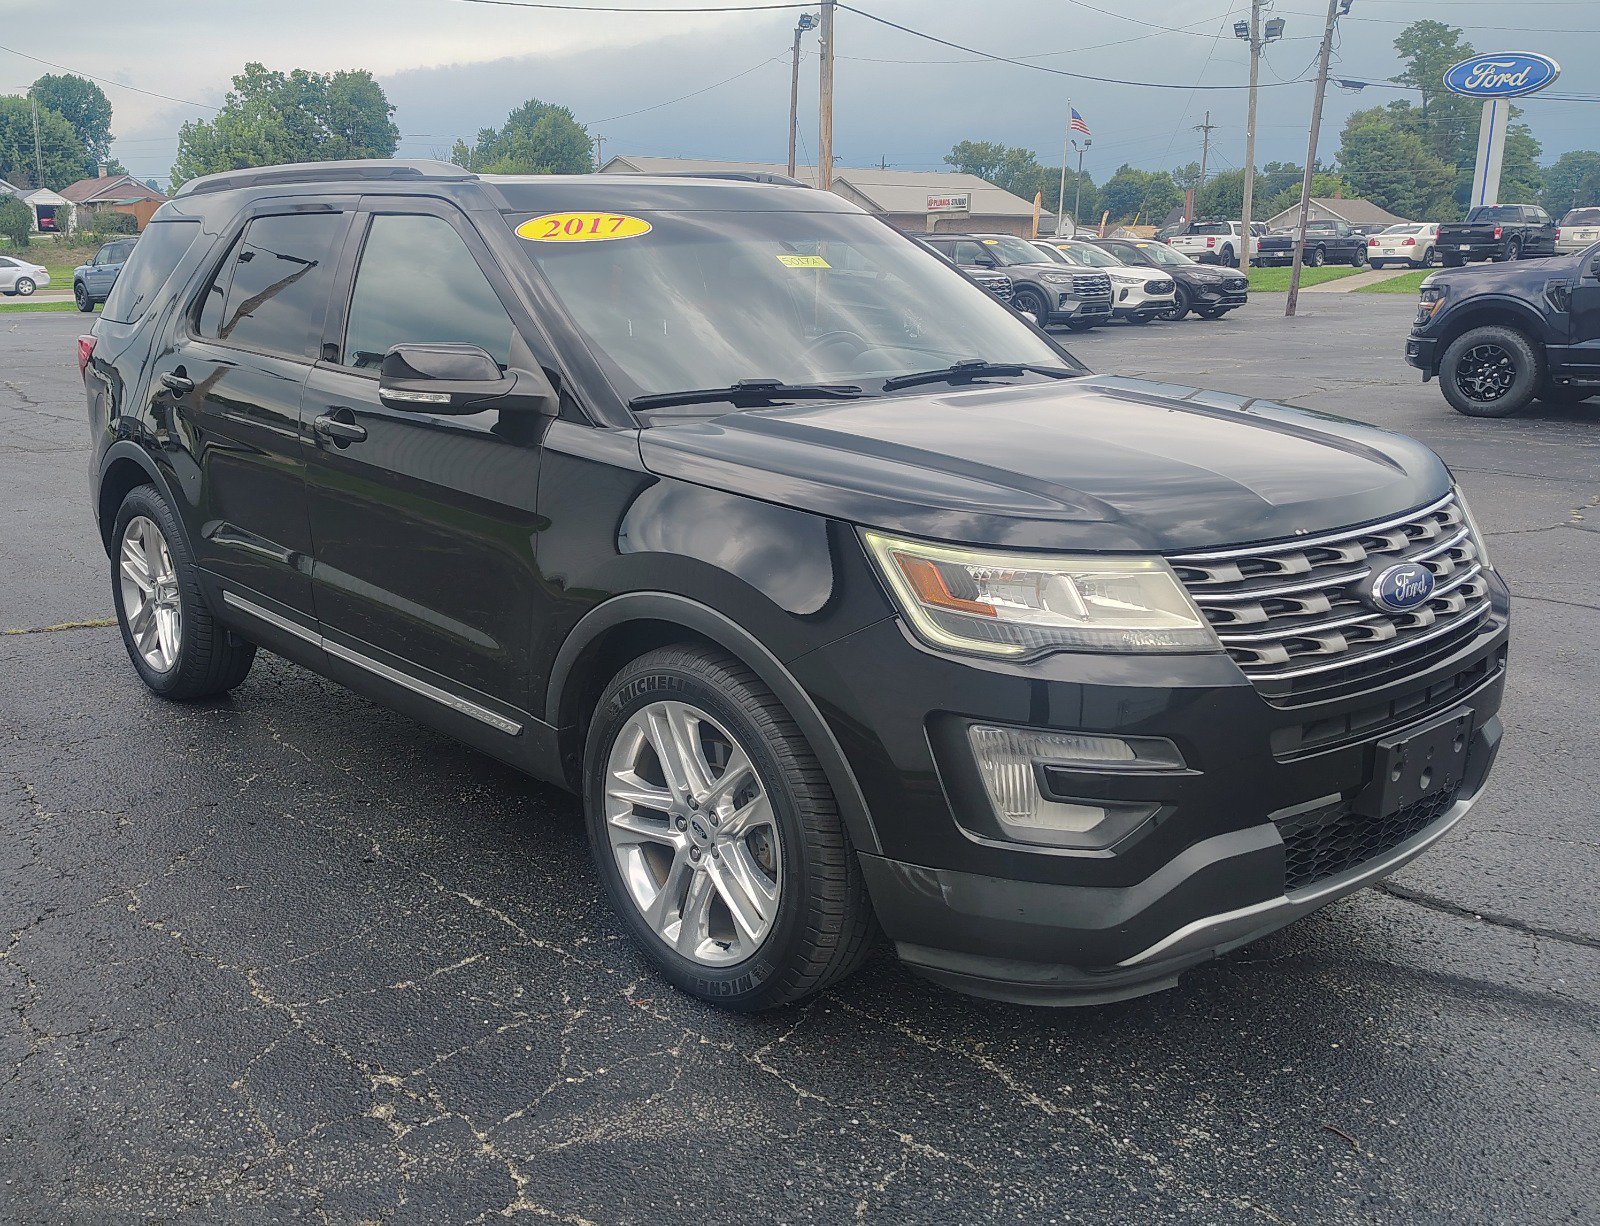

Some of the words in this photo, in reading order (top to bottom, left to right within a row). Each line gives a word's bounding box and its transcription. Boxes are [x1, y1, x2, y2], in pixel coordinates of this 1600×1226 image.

[1464, 61, 1532, 88] Ford
[541, 217, 626, 239] 2017
[1395, 570, 1428, 602] Ford
